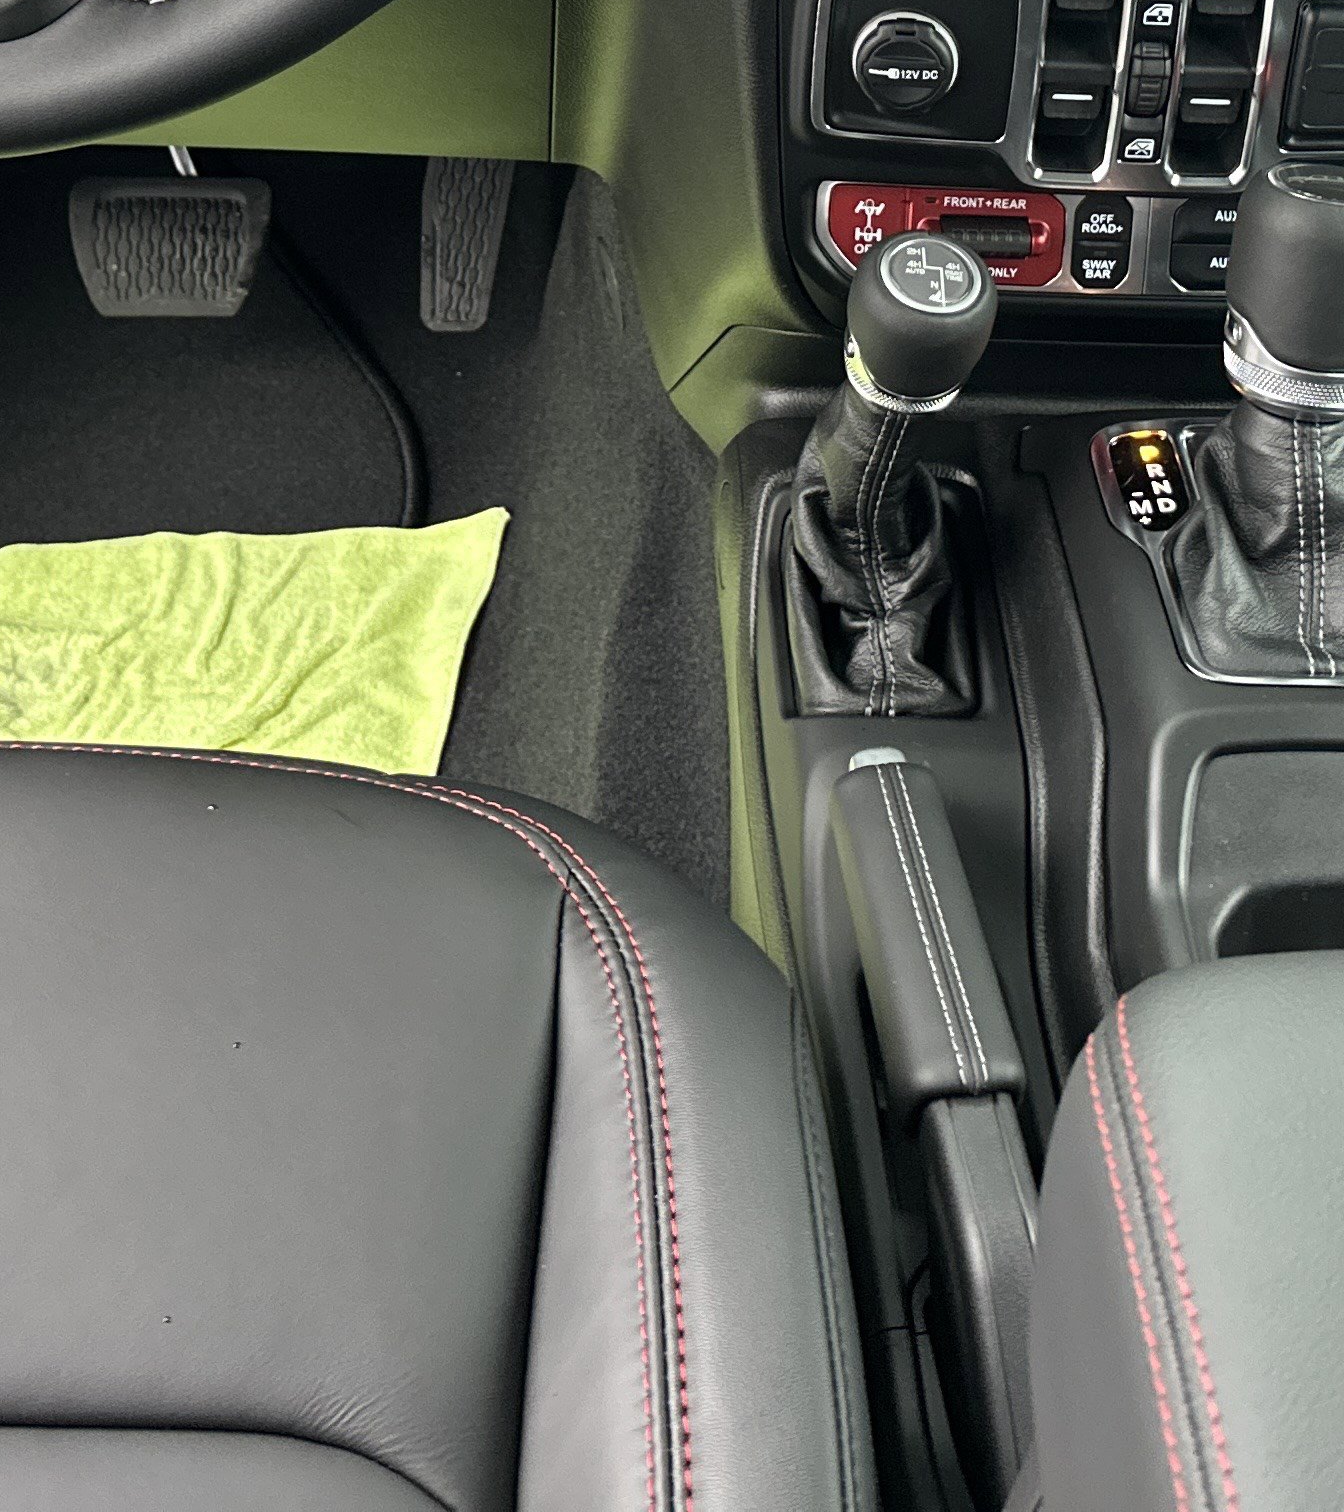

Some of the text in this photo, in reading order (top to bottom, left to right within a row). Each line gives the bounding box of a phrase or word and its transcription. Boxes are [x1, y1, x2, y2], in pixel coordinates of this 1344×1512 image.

[900, 69, 939, 80] 12V DC
[943, 196, 1028, 210] FRONT+REAR
[1090, 213, 1115, 224] OFF
[1081, 223, 1124, 234] ROAD+
[906, 259, 922, 268] 4H
[945, 262, 960, 271] 4H
[1082, 259, 1117, 270] SWAY
[1084, 268, 1111, 279] BAR
[930, 280, 939, 289] N
[1145, 463, 1165, 478] R
[1151, 479, 1172, 495] N
[1129, 499, 1153, 515] M
[1156, 497, 1177, 513] D
